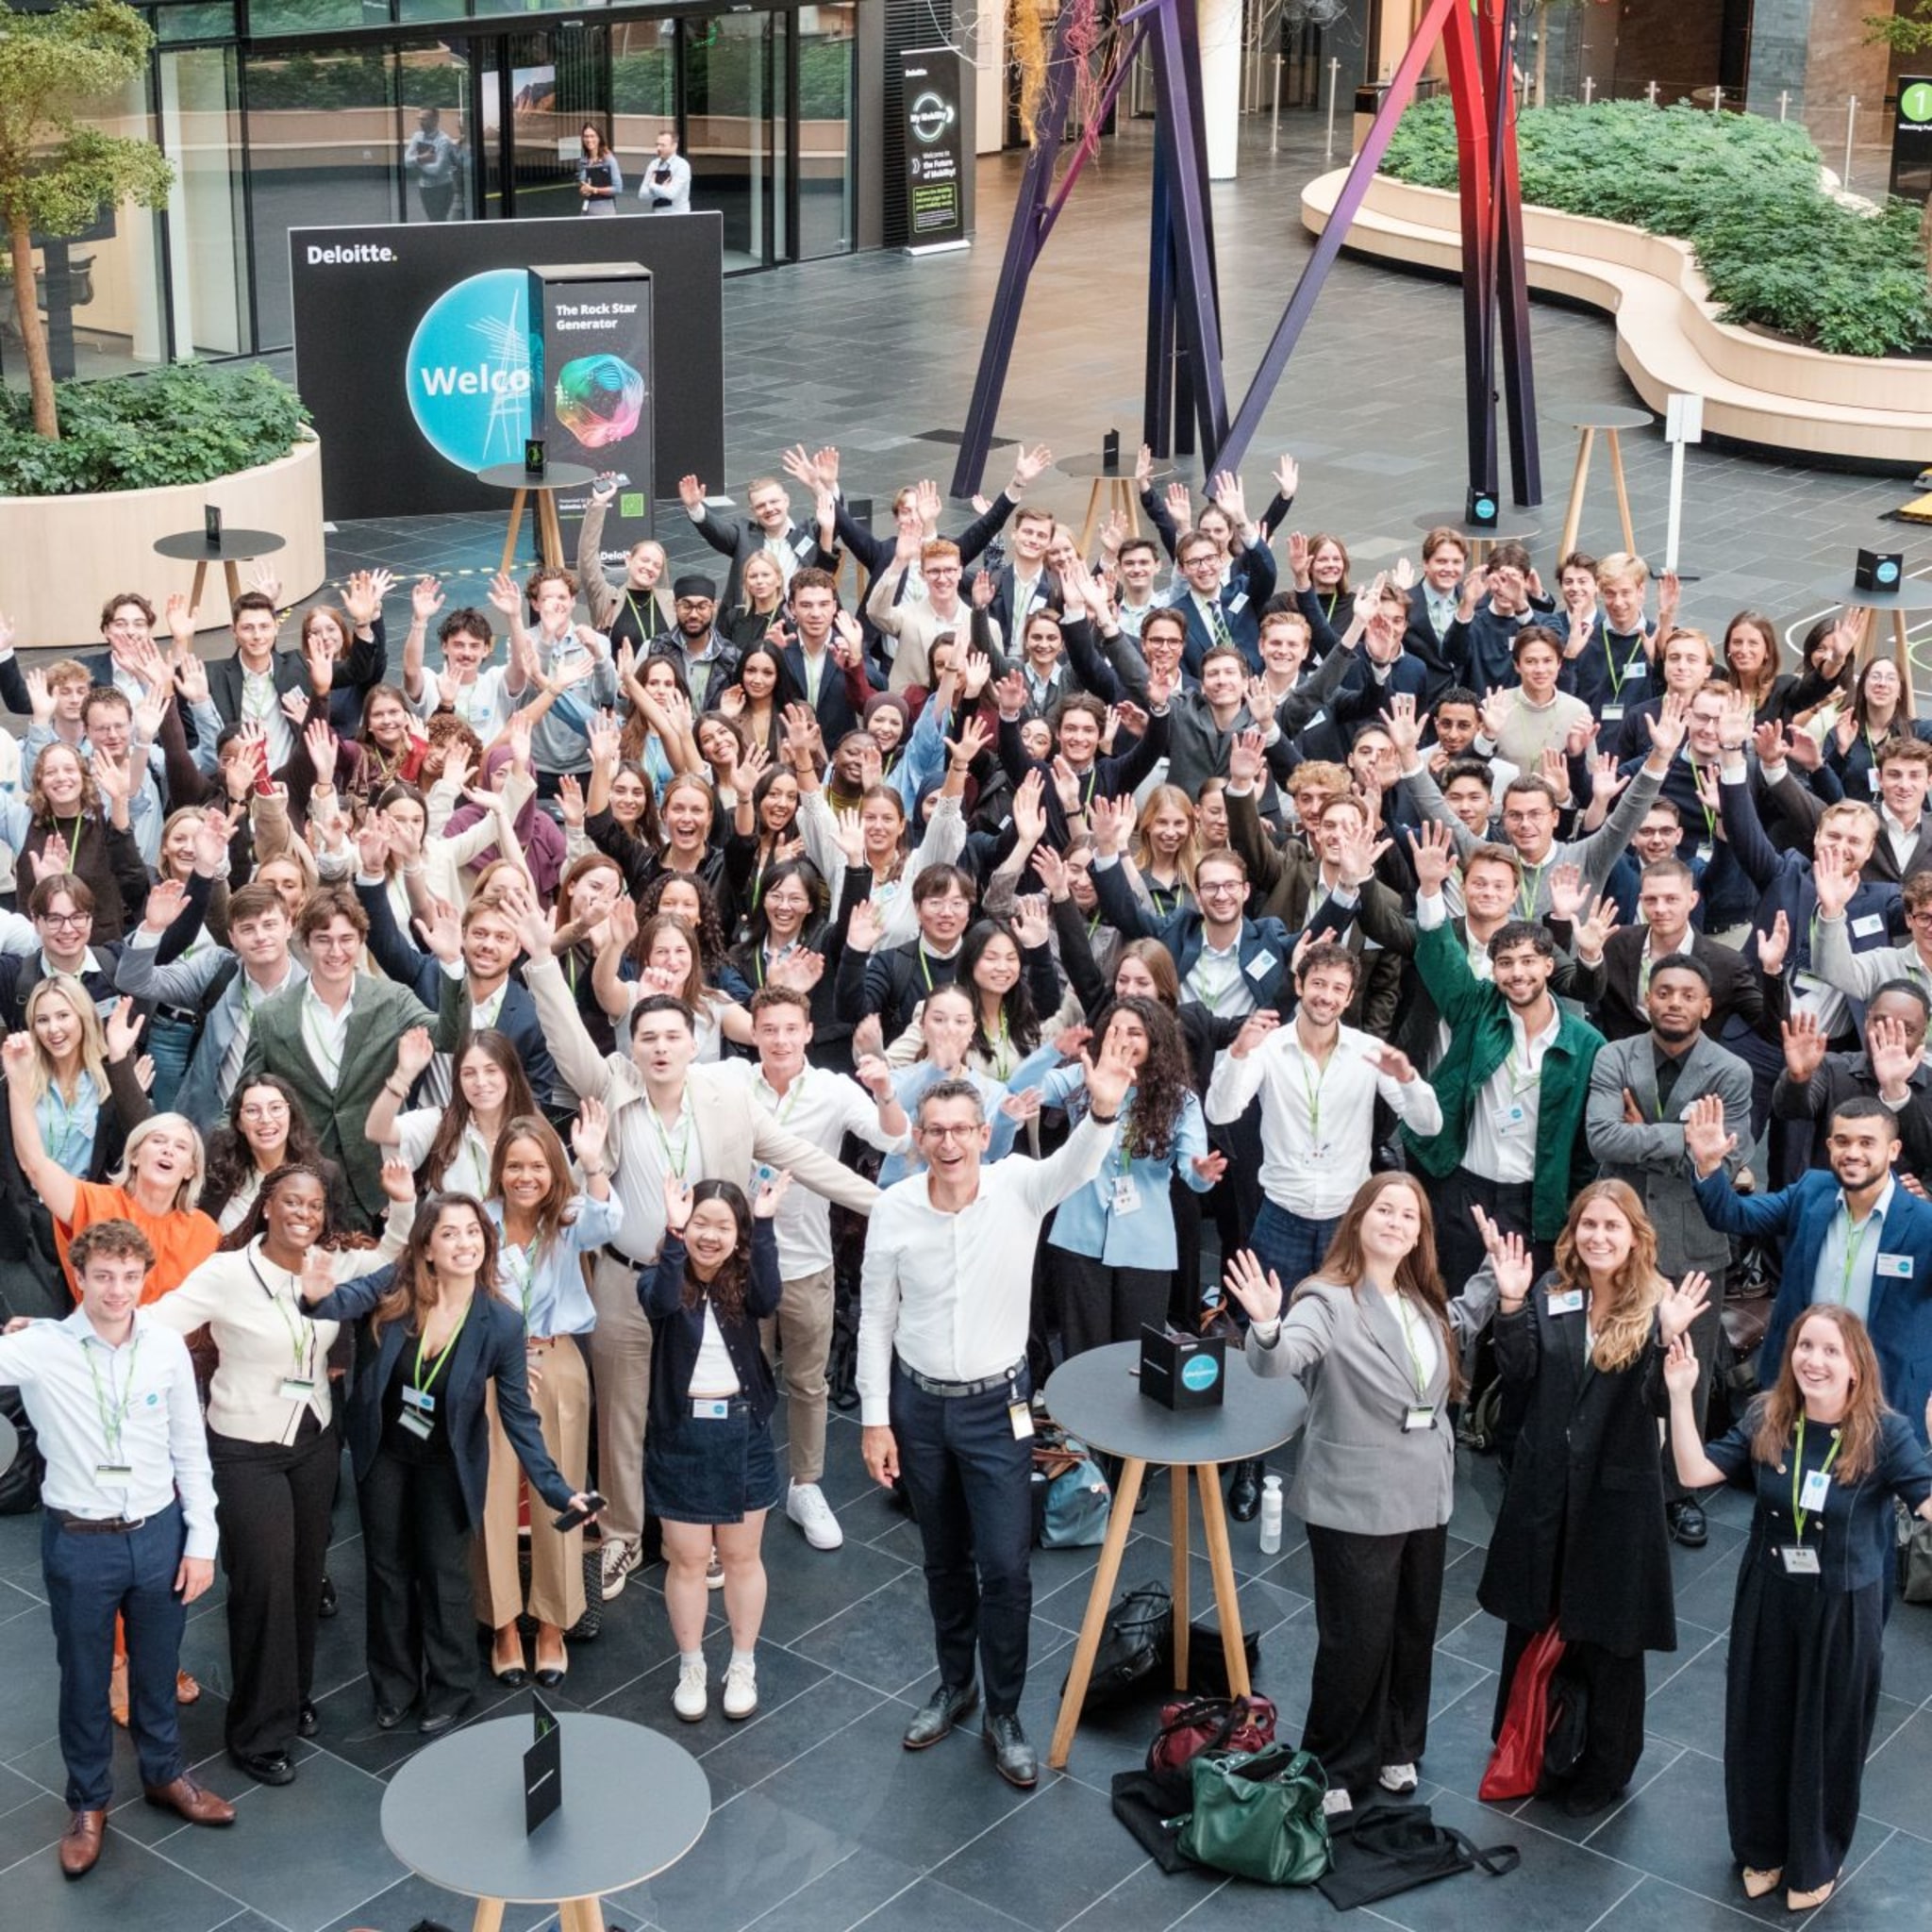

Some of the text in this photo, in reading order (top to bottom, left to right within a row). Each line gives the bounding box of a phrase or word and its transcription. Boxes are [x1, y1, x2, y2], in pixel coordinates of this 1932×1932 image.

[1914, 90, 1925, 115] 1
[307, 243, 398, 265] Deloitte.
[556, 303, 638, 316] The Rock Star
[557, 319, 618, 330] Generator
[420, 362, 530, 396] Welco
[600, 550, 631, 561] Deloi
